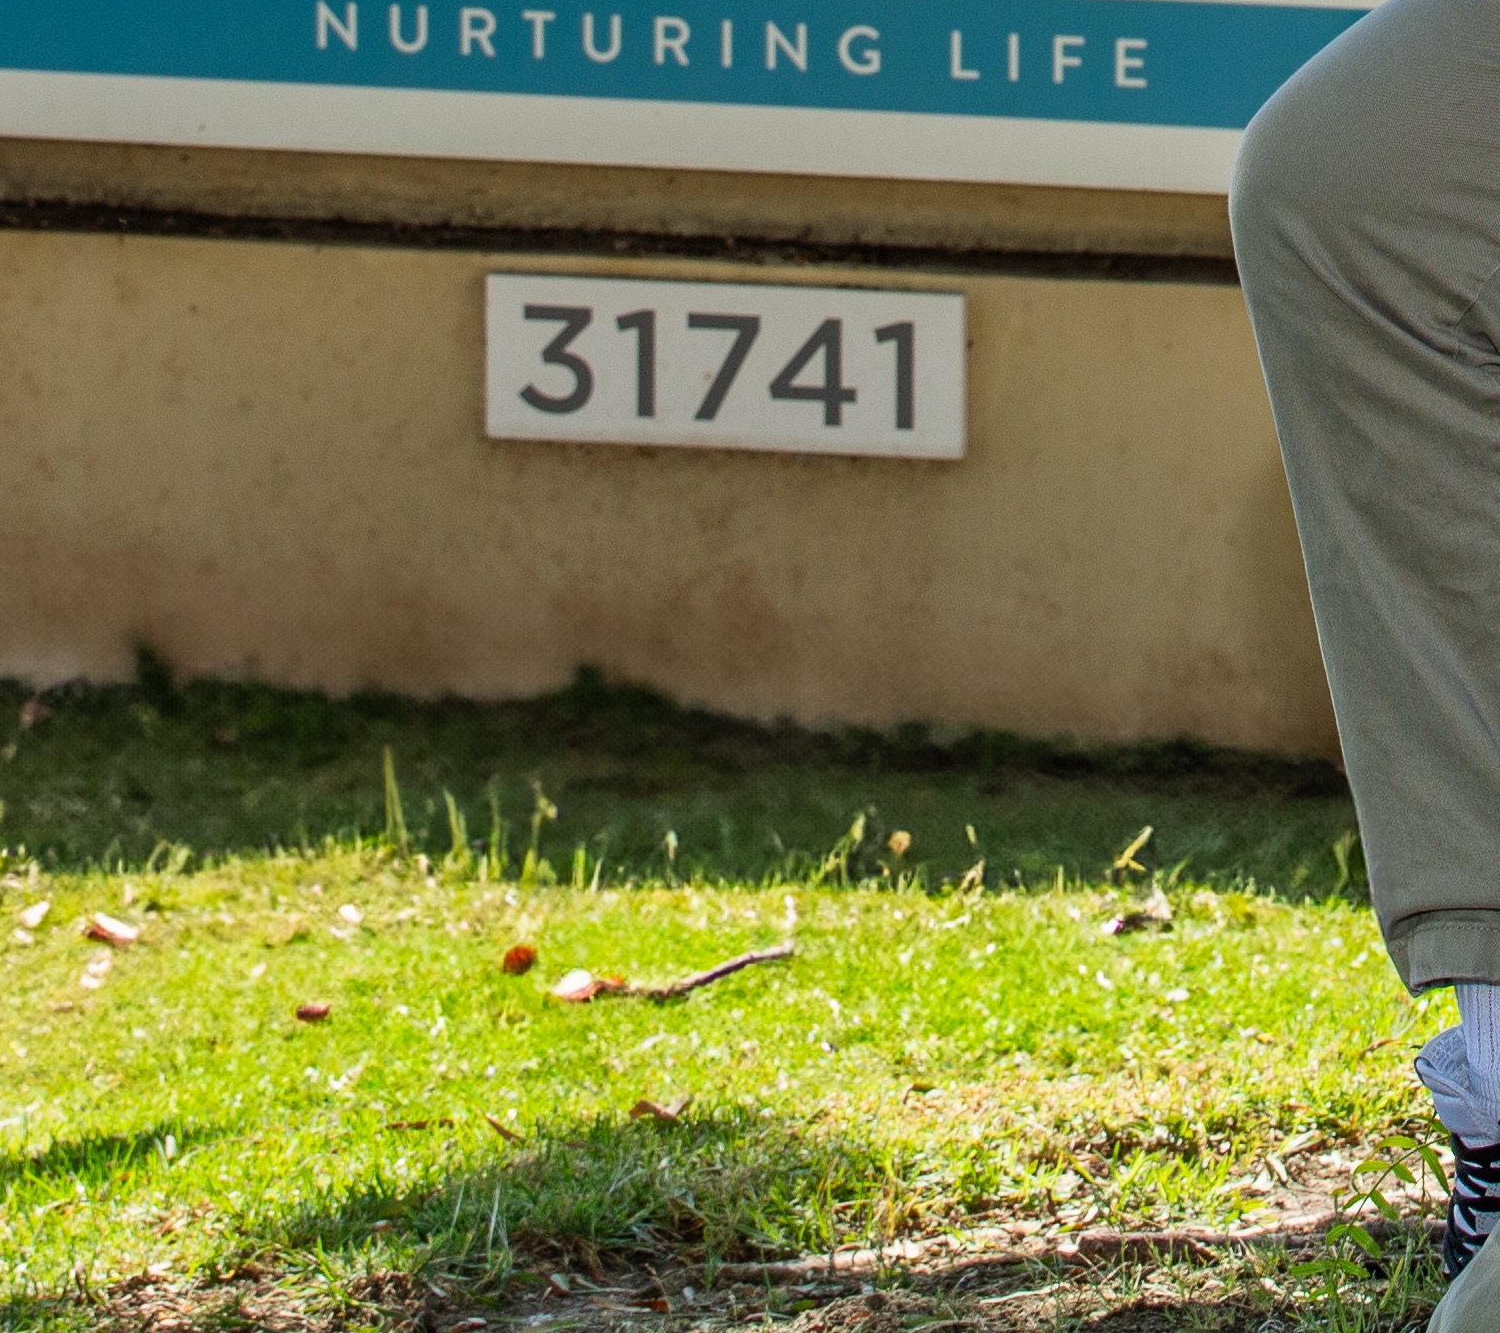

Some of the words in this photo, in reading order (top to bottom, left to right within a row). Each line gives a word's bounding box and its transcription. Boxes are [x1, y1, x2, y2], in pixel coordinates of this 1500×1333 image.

[314, 0, 883, 76] NURTURING
[949, 29, 1150, 89] LIFE
[519, 303, 915, 431] 31741
